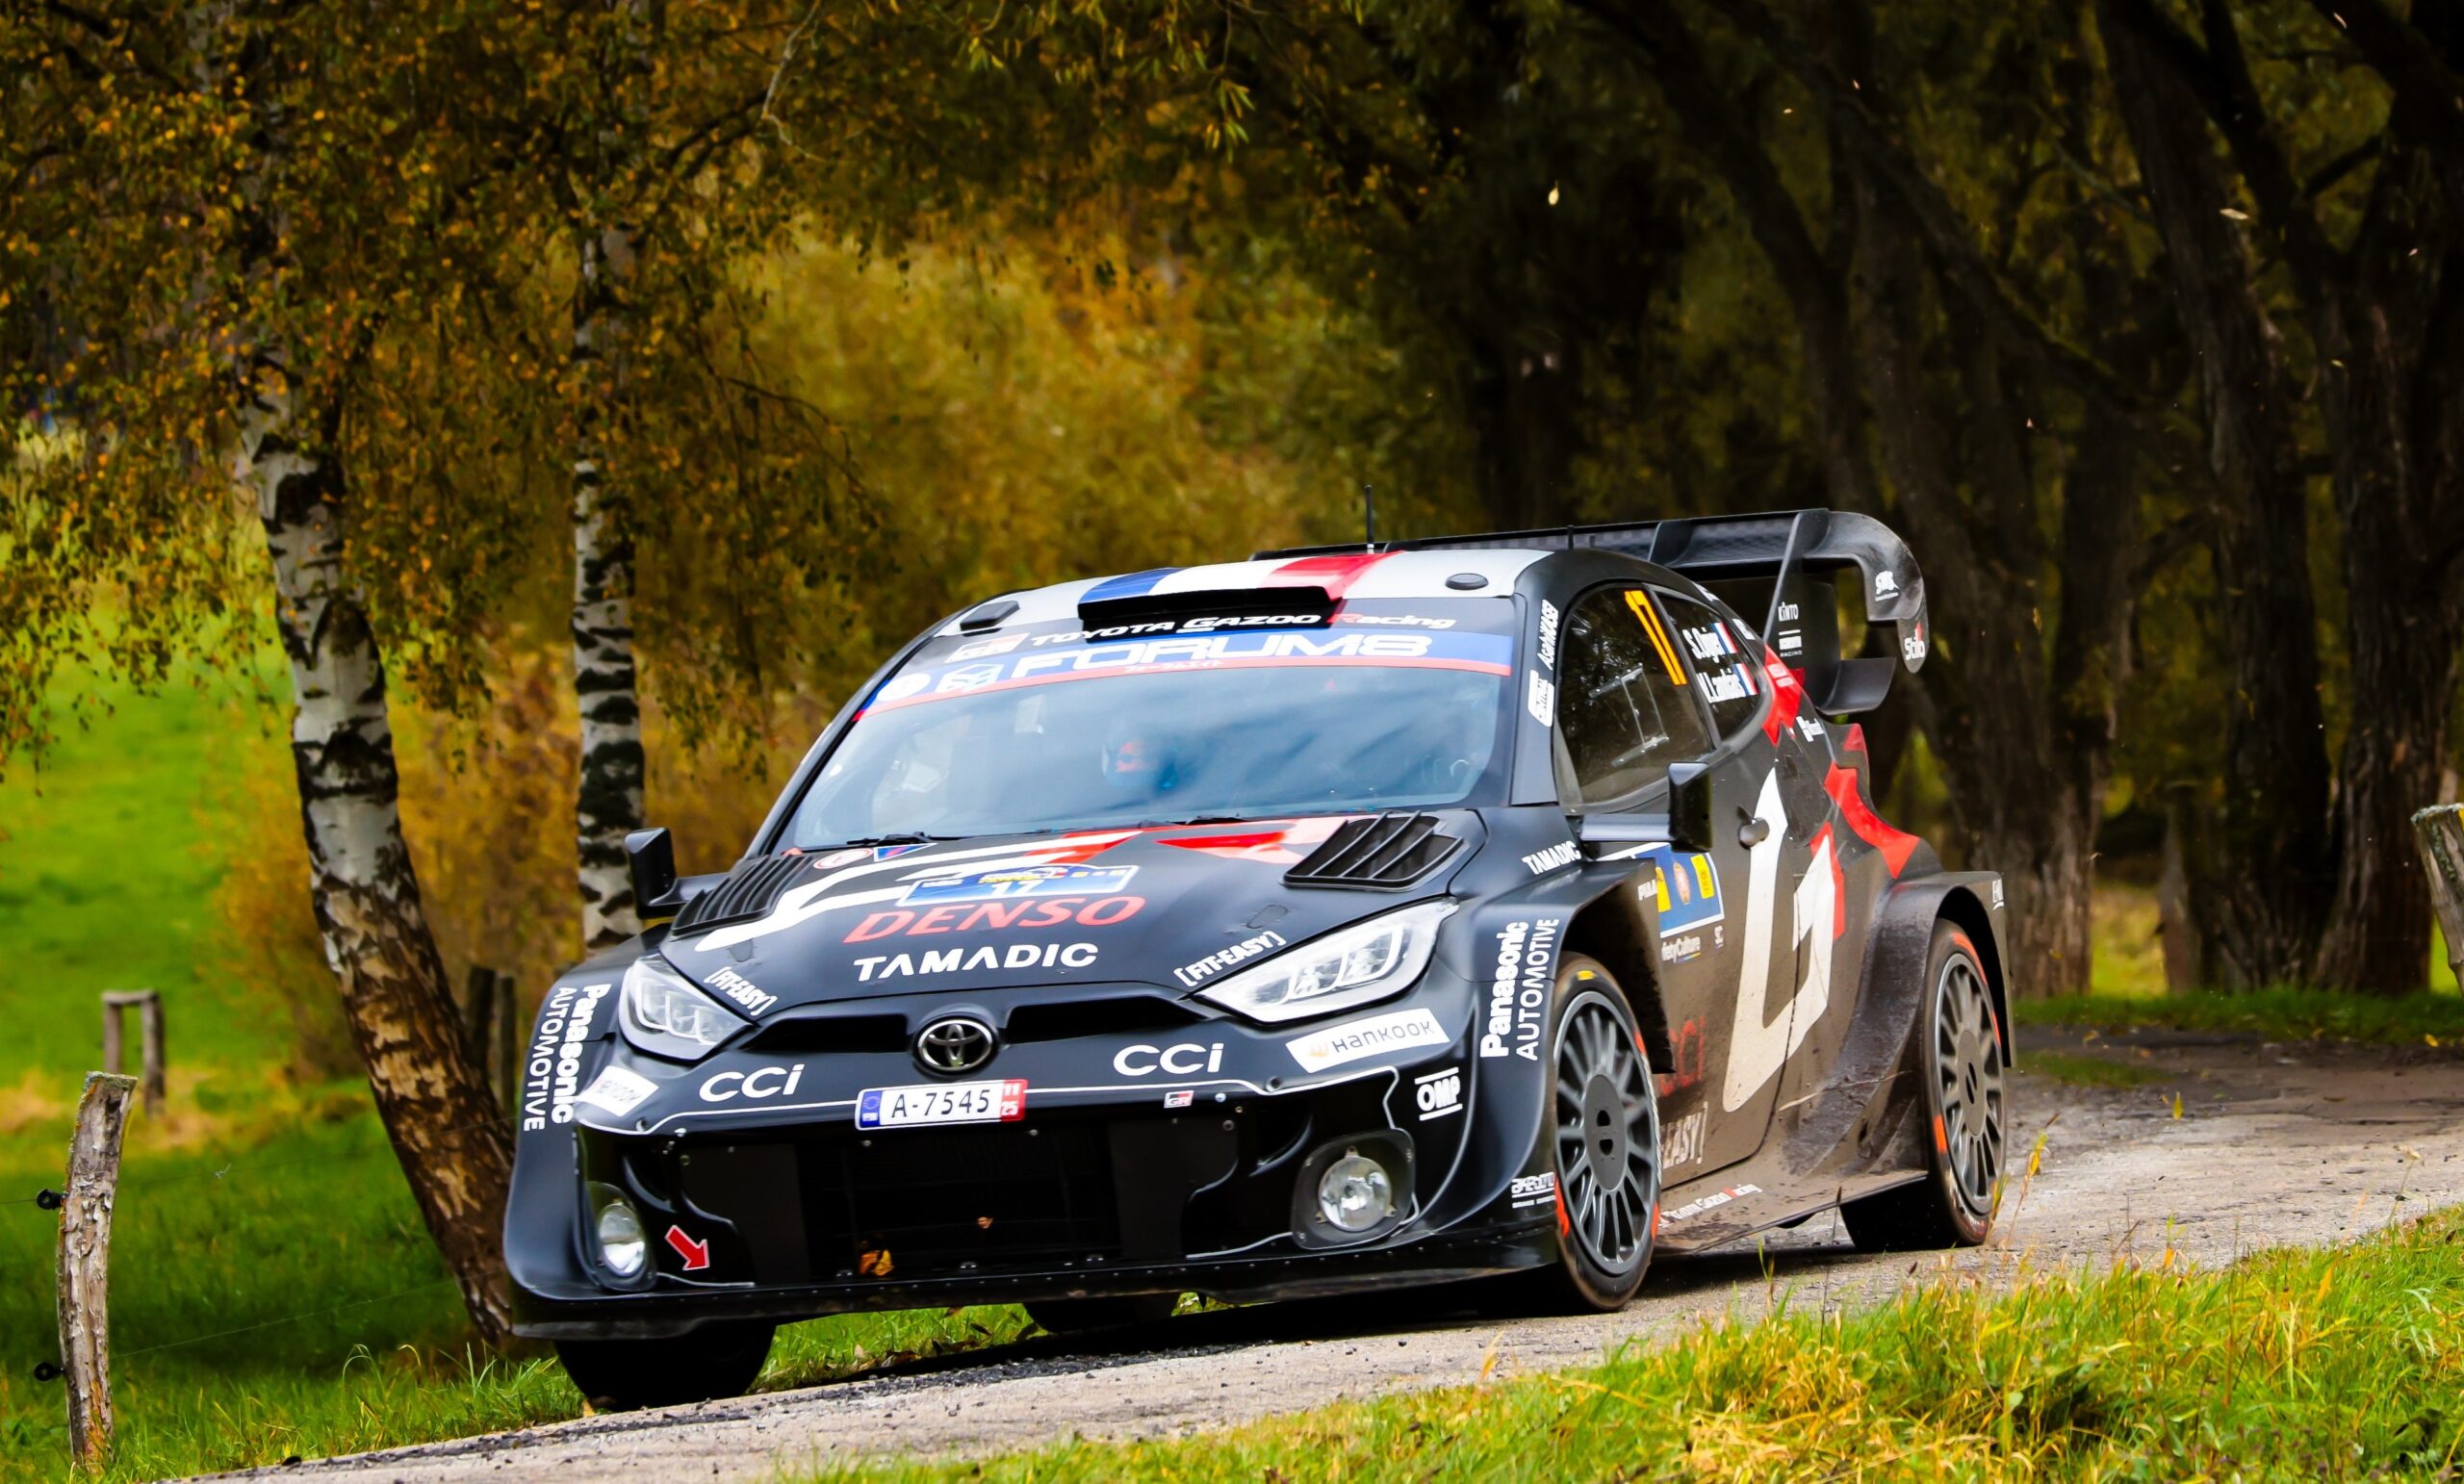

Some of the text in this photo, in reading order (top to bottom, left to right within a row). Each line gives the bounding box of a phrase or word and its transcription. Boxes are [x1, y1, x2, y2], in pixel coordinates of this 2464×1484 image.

[1030, 613, 1456, 646] TOYOTA GAZOO Racing
[1624, 590, 1687, 686] 17
[1011, 633, 1433, 678] FORUM8
[1522, 840, 1582, 875] TAMADIC
[991, 879, 1045, 897] 17
[843, 895, 1147, 943] DENSO
[853, 942, 1099, 982] TAMADIC
[1479, 920, 1529, 1059] Panasonic
[1516, 918, 1560, 1062] AUTOMOTIVE
[524, 985, 571, 1132] AUTOMOTIVE
[551, 983, 613, 1124] Panasonic
[891, 1088, 990, 1118] A-7545
[1000, 1100, 1019, 1116] 25
[1003, 1083, 1021, 1096] 11
[1416, 1075, 1461, 1112] OMP
